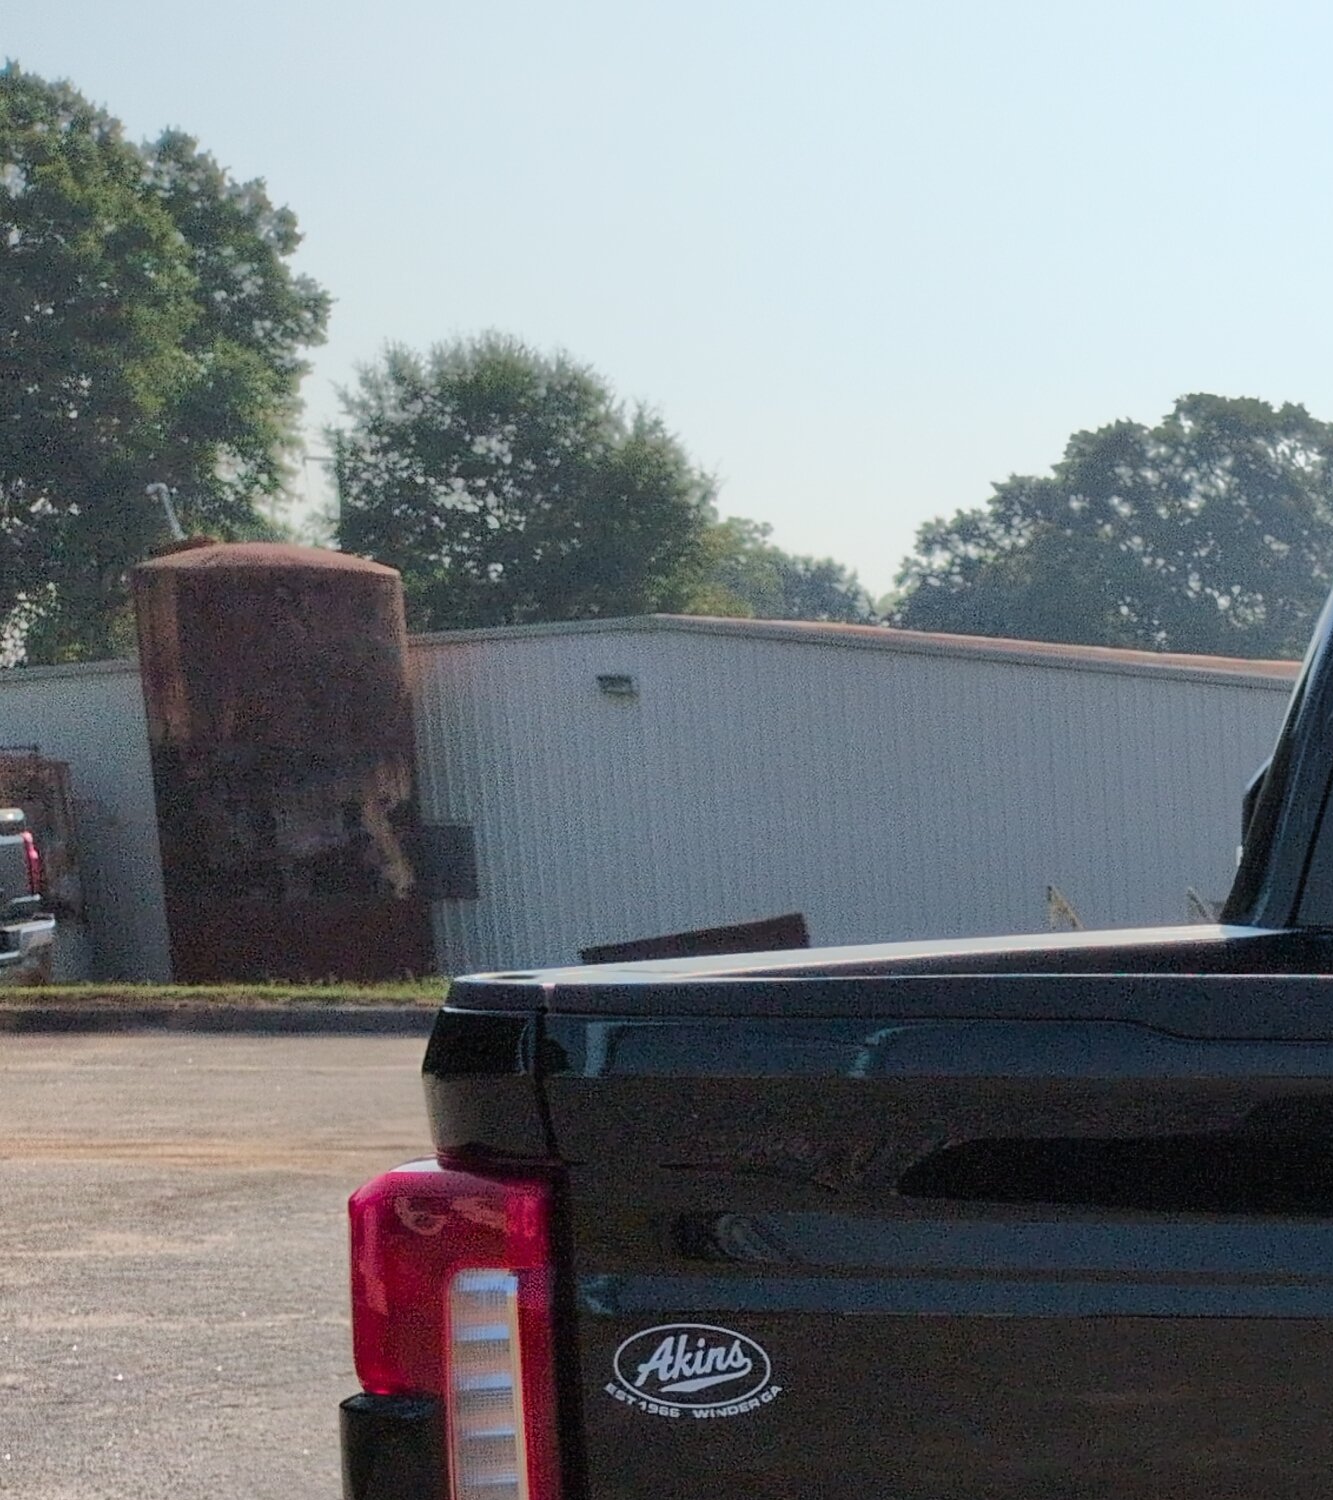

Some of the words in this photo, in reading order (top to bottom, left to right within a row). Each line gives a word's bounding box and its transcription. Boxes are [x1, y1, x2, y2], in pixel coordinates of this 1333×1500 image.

[635, 1334, 752, 1392] Akins
[603, 1383, 637, 1405] EST
[639, 1401, 681, 1418] 1966
[692, 1398, 760, 1419] WINDER
[761, 1386, 783, 1403] GA
